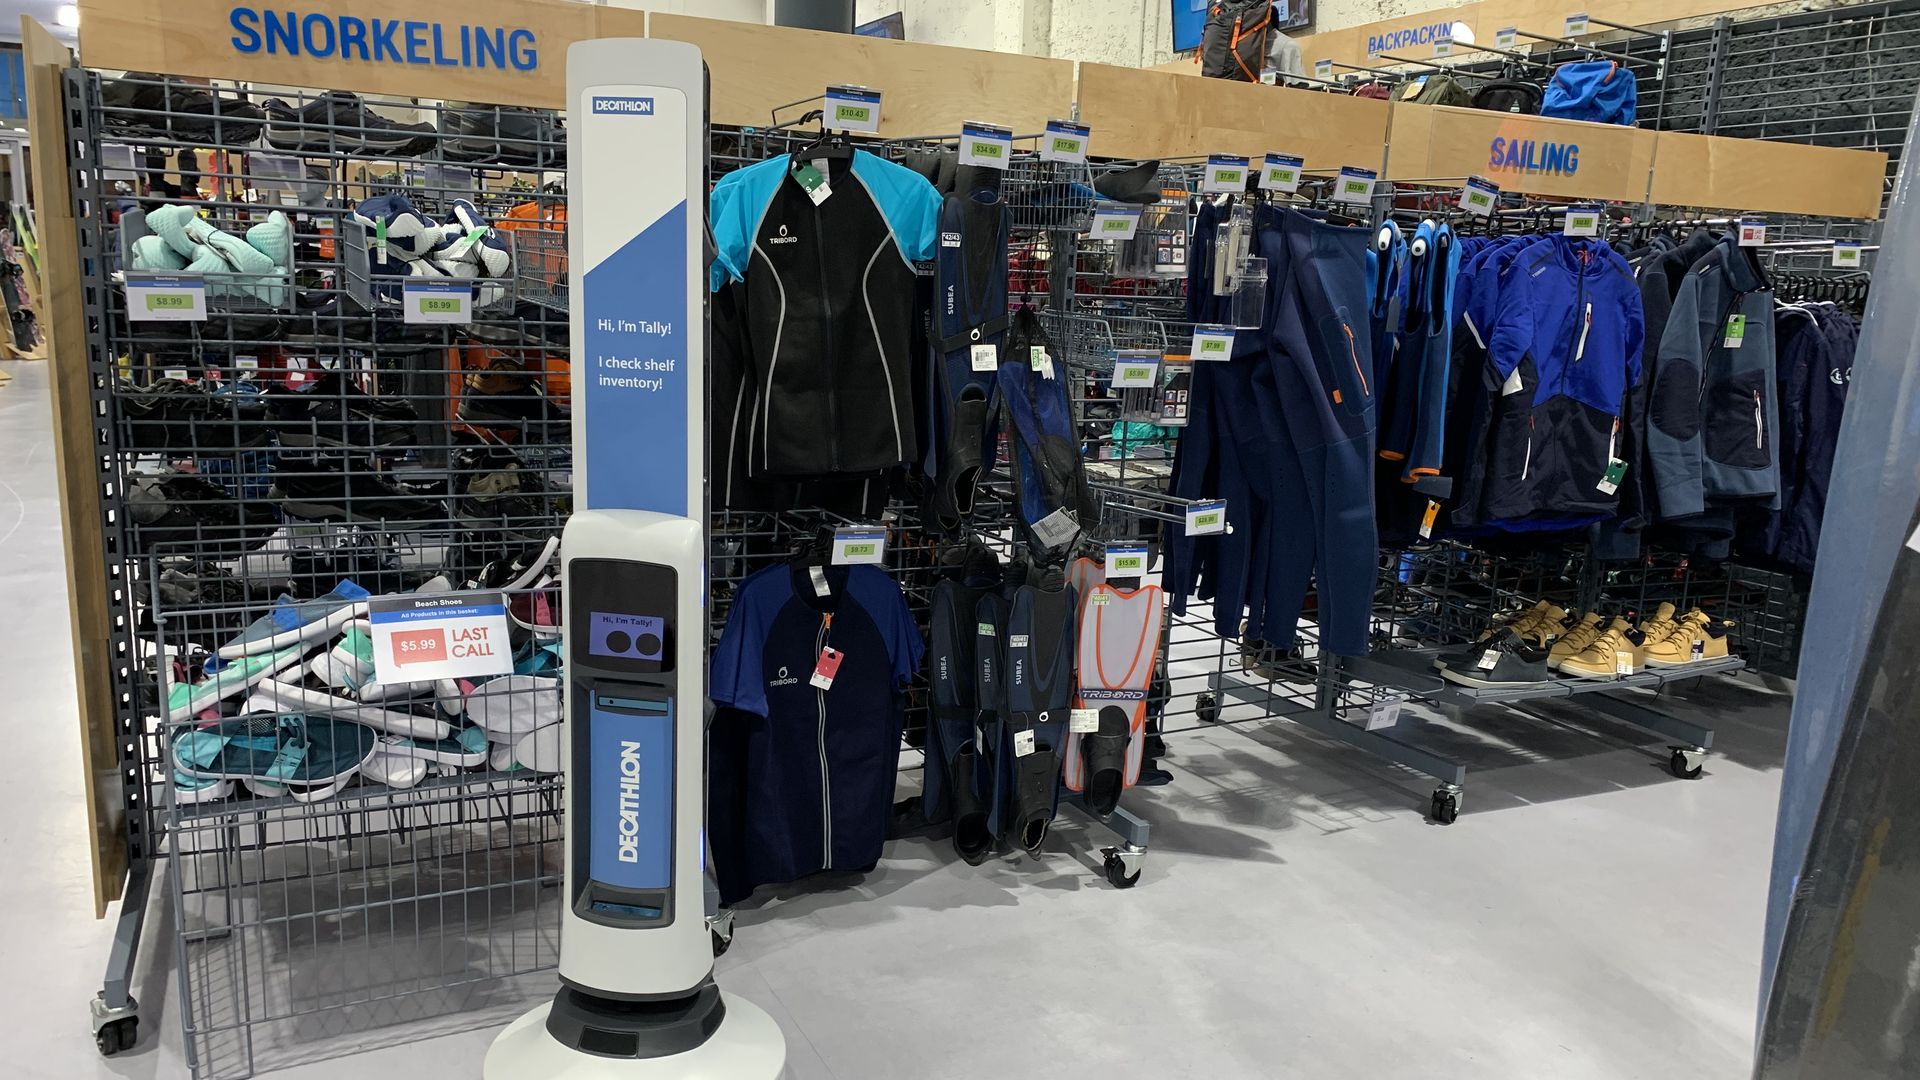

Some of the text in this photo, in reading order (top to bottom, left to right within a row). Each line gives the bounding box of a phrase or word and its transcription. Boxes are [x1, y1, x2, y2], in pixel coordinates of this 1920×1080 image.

[229, 7, 537, 71] SNORKELING
[1368, 21, 1457, 54] BACKPACKIN
[596, 100, 651, 112] DECATHLON
[841, 108, 864, 118] $10.43
[976, 145, 997, 154] $34.90
[1489, 136, 1579, 174] SAILING
[769, 236, 798, 244] TRIBORD
[156, 297, 182, 305] $8.99
[428, 301, 451, 309] $8.99
[598, 318, 672, 337] Hi, I'm Tally!
[599, 355, 675, 372] I check shelf
[599, 374, 663, 392] inventory!
[1118, 559, 1136, 567] $15.90
[415, 600, 438, 608] Beach
[602, 616, 614, 625] Hi,
[630, 618, 653, 627] Tally!
[401, 626, 489, 653] $5.99 LAST
[452, 642, 495, 658] CALL
[1015, 659, 1023, 685] SUBEA
[770, 677, 798, 688] TRIBORD
[1082, 690, 1144, 699] TRIBORD
[619, 741, 641, 863] DECATHLON
